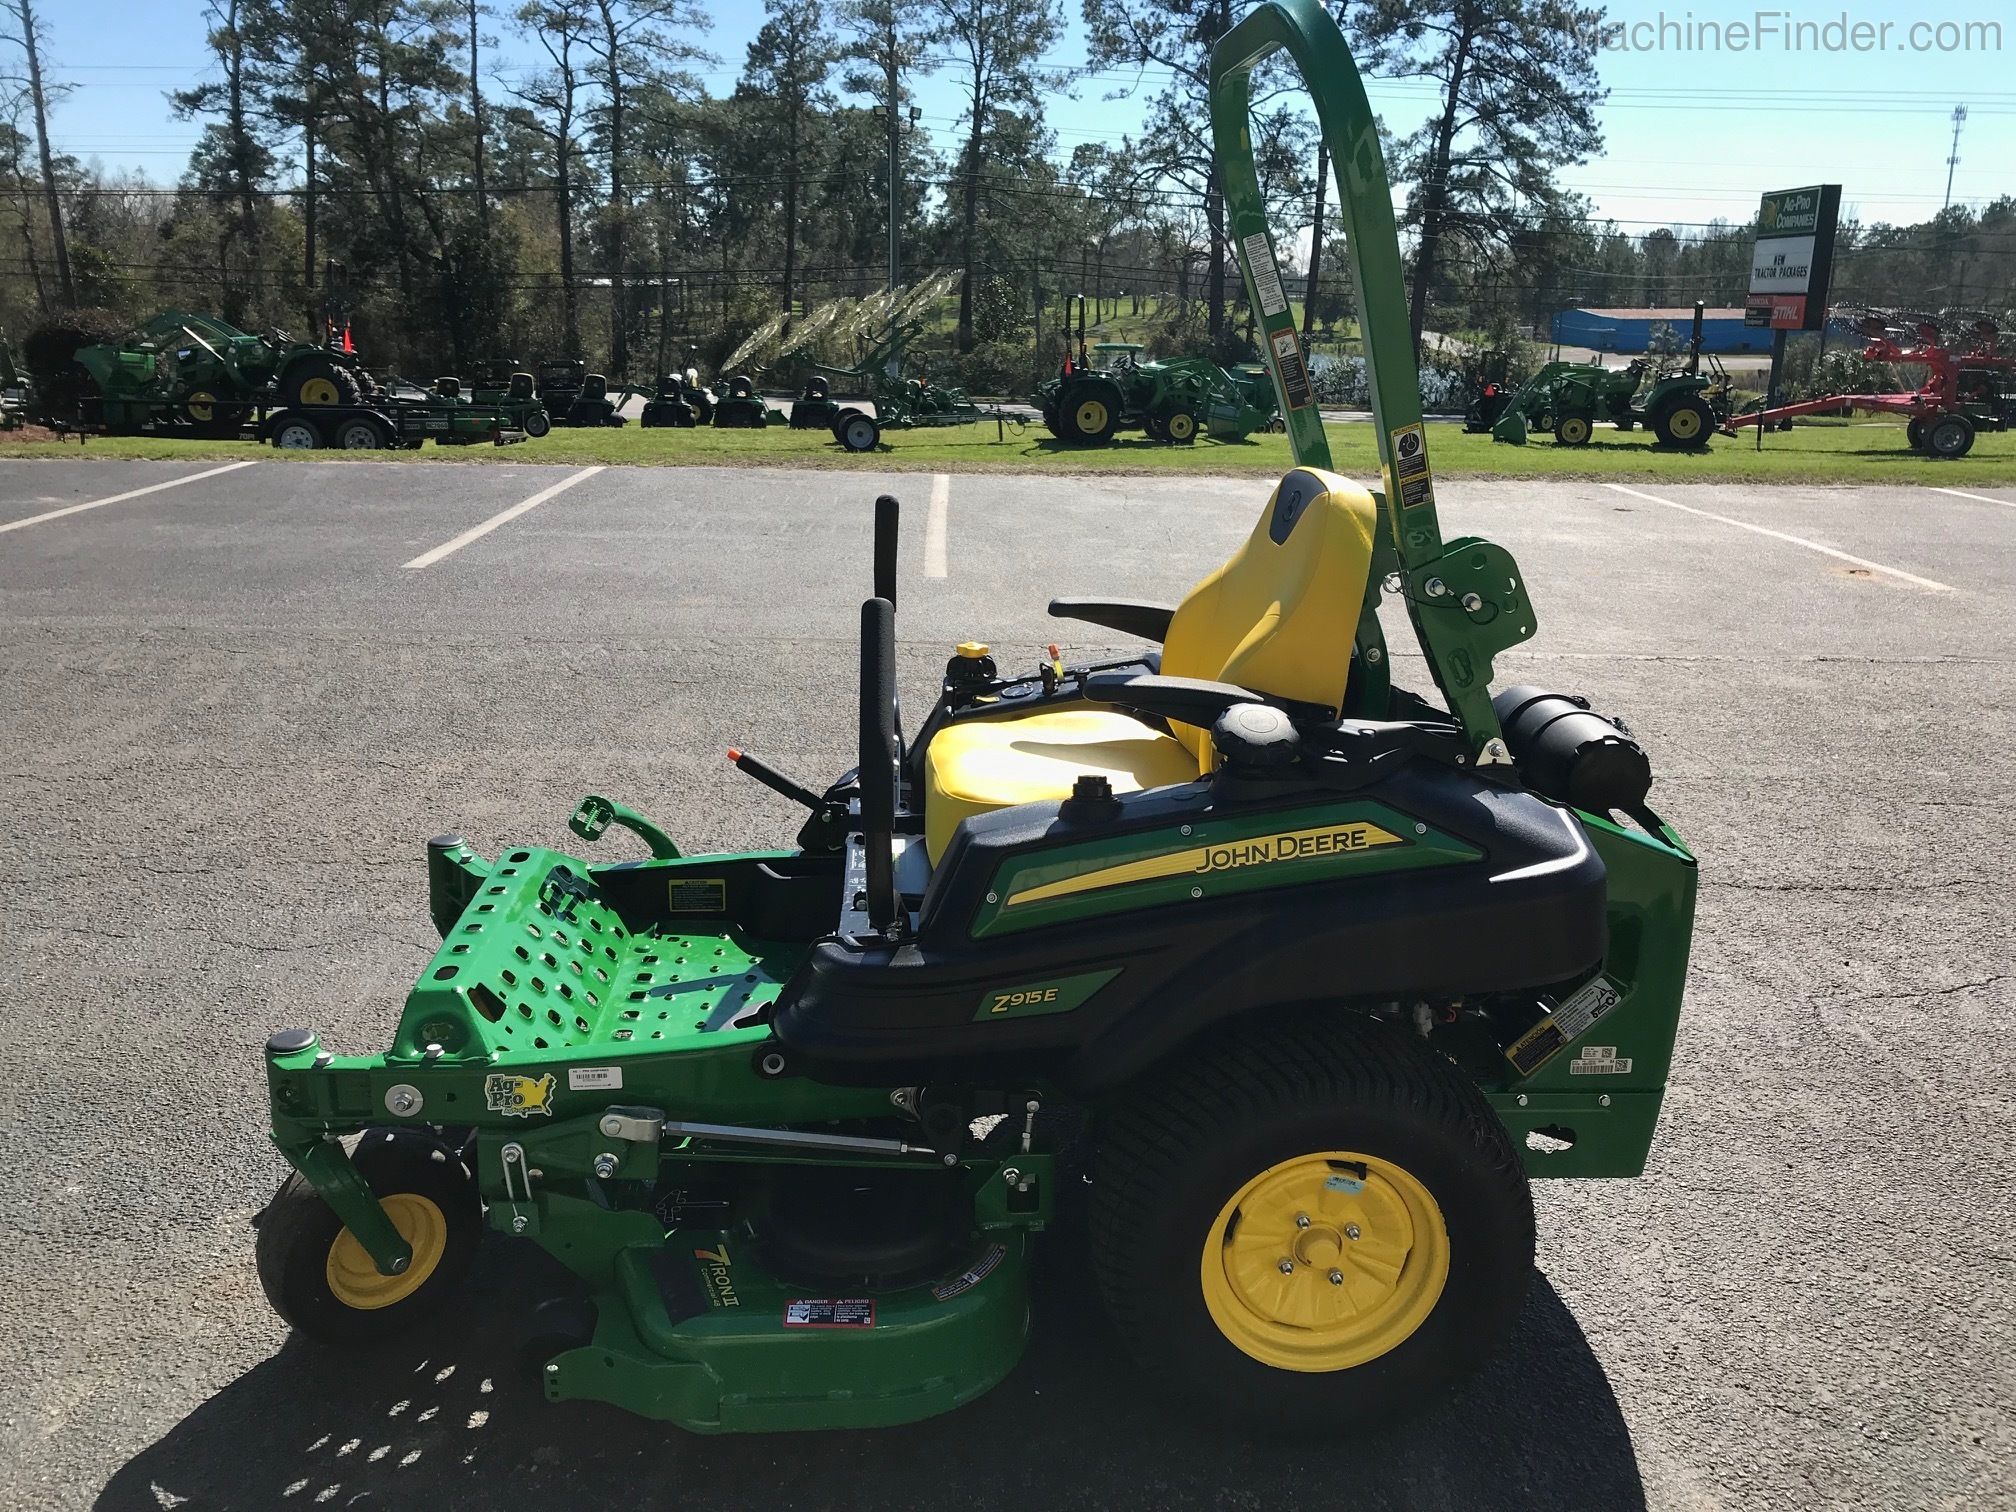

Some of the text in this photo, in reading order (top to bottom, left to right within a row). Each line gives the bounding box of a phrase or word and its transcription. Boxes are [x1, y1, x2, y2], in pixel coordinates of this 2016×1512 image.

[1773, 254, 1786, 265] NEW
[1754, 265, 1808, 279] TRACTOR PACKAGES
[1771, 305, 1798, 320] STIHL
[991, 987, 1058, 1014] Z915E
[1520, 1025, 1546, 1049] ATENCIÓN
[490, 1093, 525, 1107] Pro
